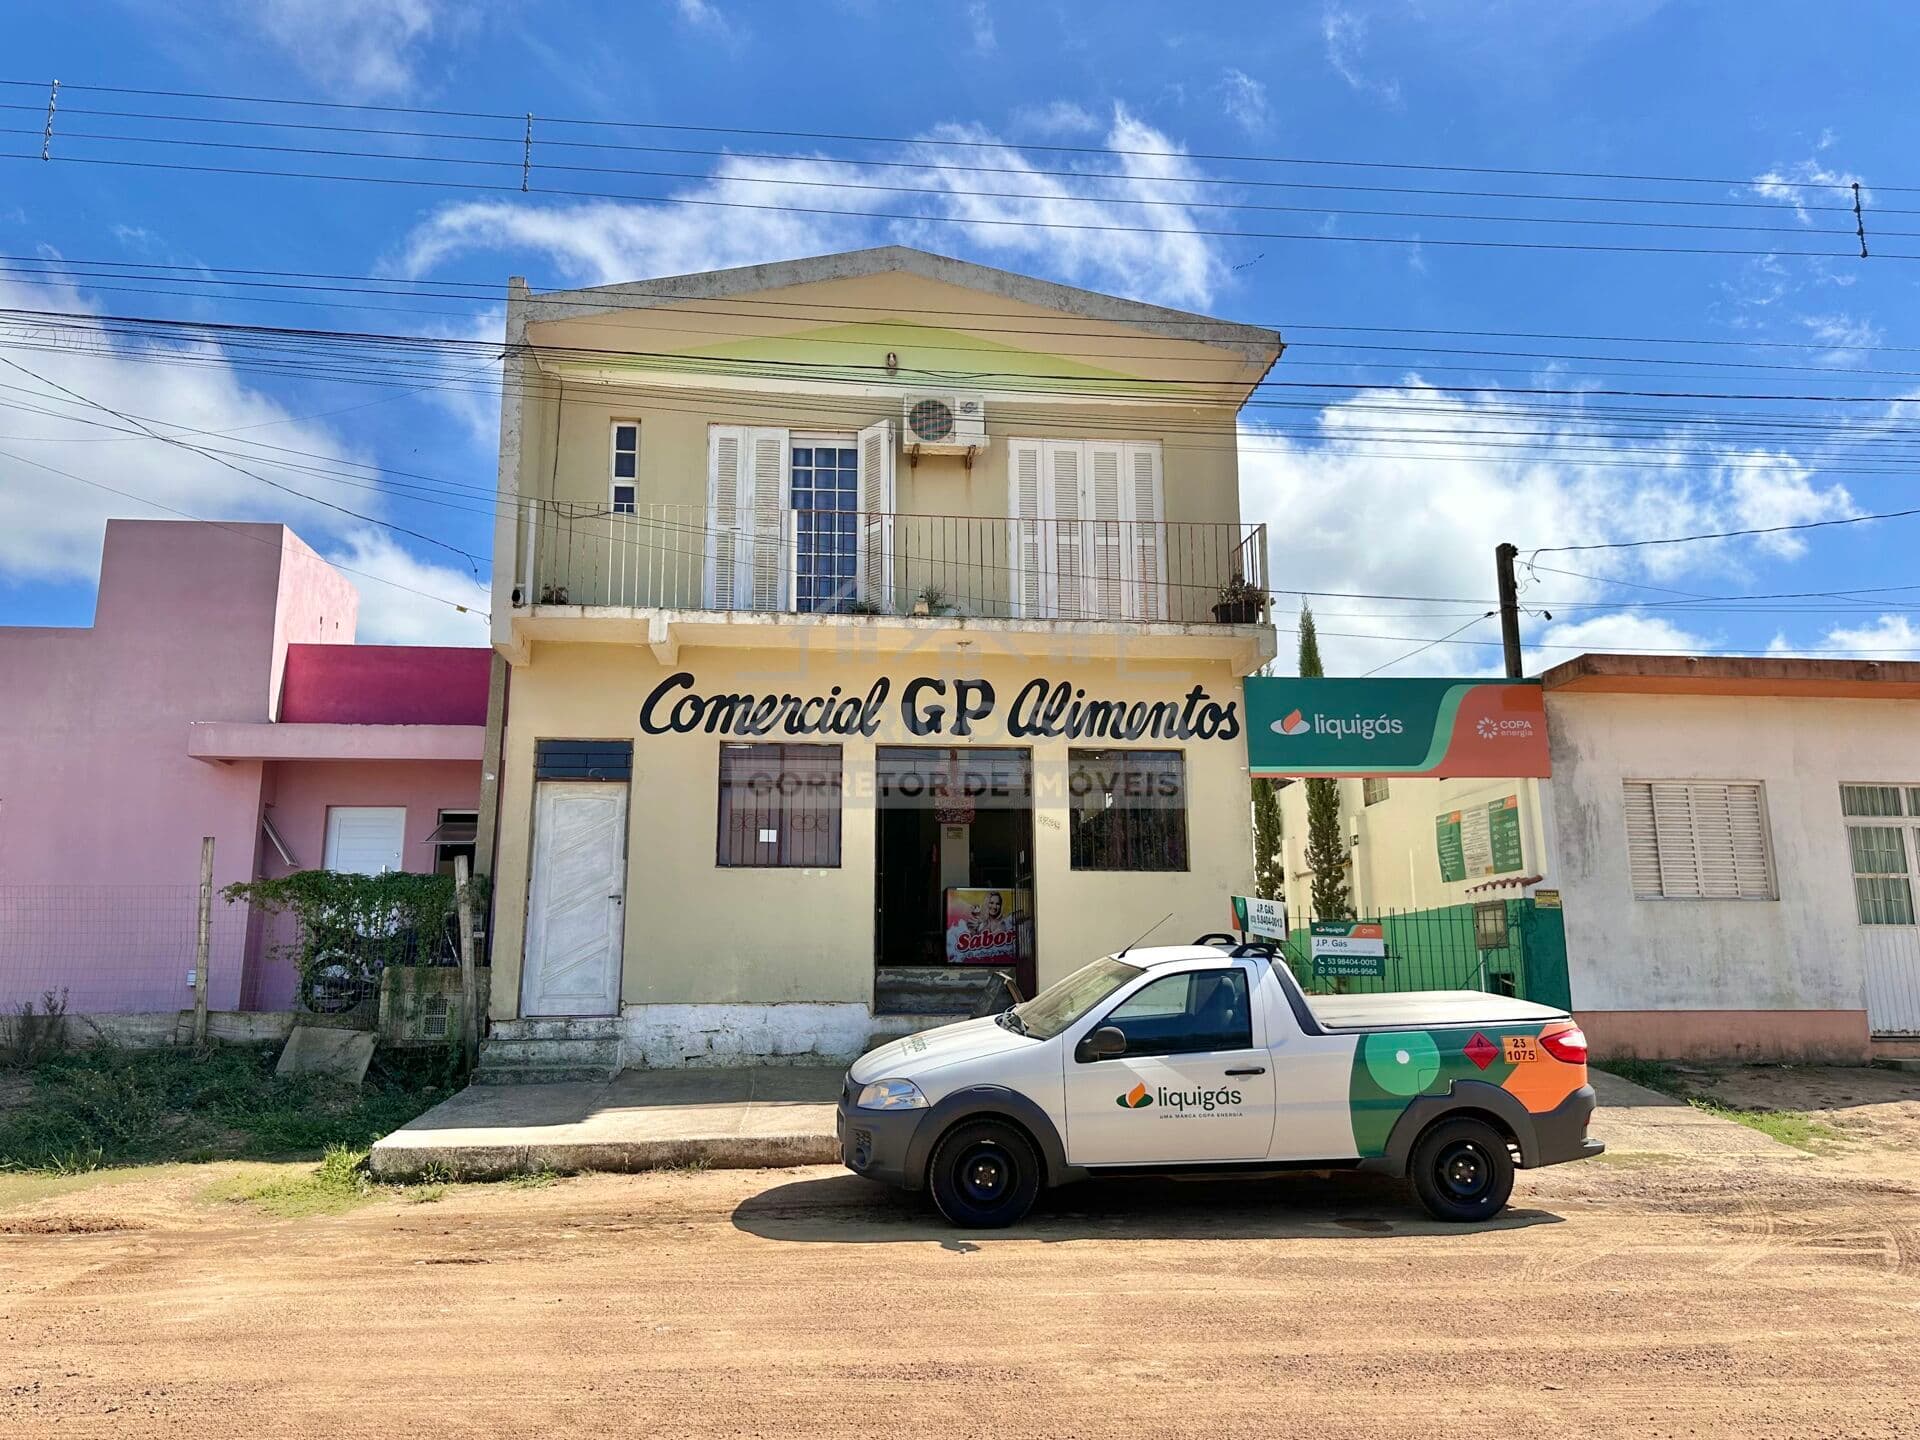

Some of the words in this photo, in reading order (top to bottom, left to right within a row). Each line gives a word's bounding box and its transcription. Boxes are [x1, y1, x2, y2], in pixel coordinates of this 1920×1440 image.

[640, 672, 890, 737] Comercial
[901, 676, 996, 736] GP
[1007, 678, 1240, 740] Alimentos
[1314, 713, 1403, 740] liquigás
[1500, 720, 1531, 729] COPA
[1500, 730, 1533, 738] energia
[1315, 939, 1330, 947] J.P.
[1331, 939, 1348, 948] Gás
[1338, 958, 1377, 966] 98404-0013
[1512, 1038, 1527, 1048] 23
[1506, 1050, 1536, 1061] 1075
[1158, 1086, 1242, 1112] liquigás
